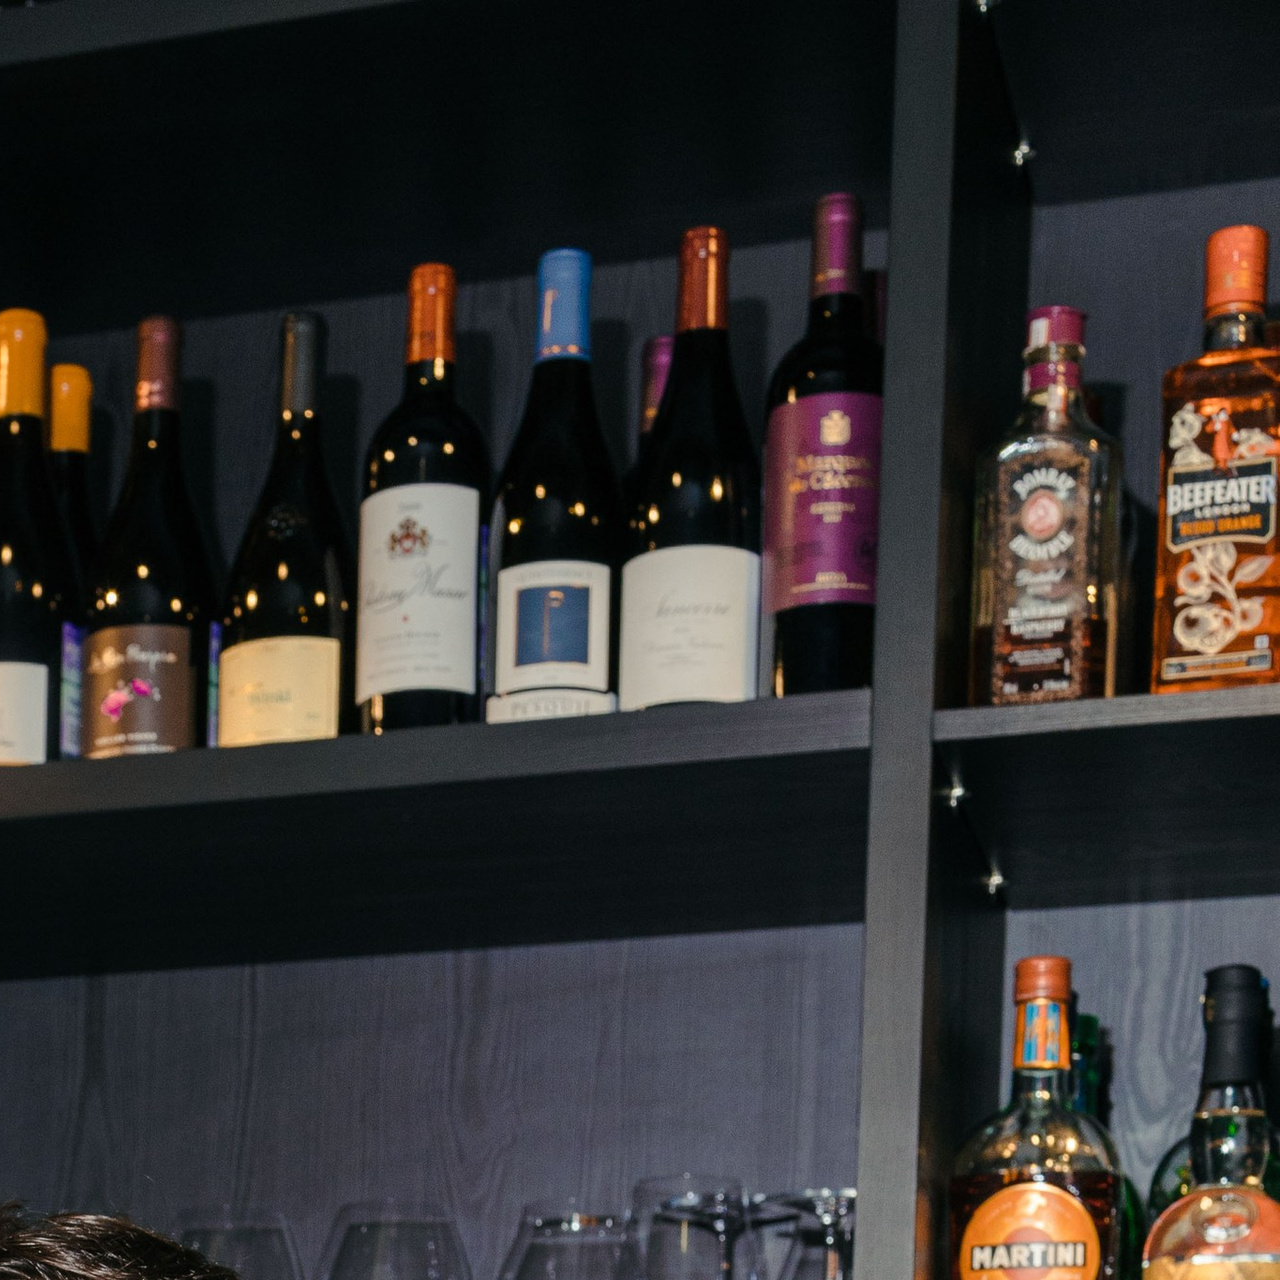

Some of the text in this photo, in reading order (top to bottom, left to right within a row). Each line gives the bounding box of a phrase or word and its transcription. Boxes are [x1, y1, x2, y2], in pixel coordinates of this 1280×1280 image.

[1166, 474, 1276, 516] BEEFEATER
[1194, 501, 1250, 518] LONDON
[1218, 514, 1261, 532] ORANGE
[972, 1242, 1085, 1270] MARTINI
